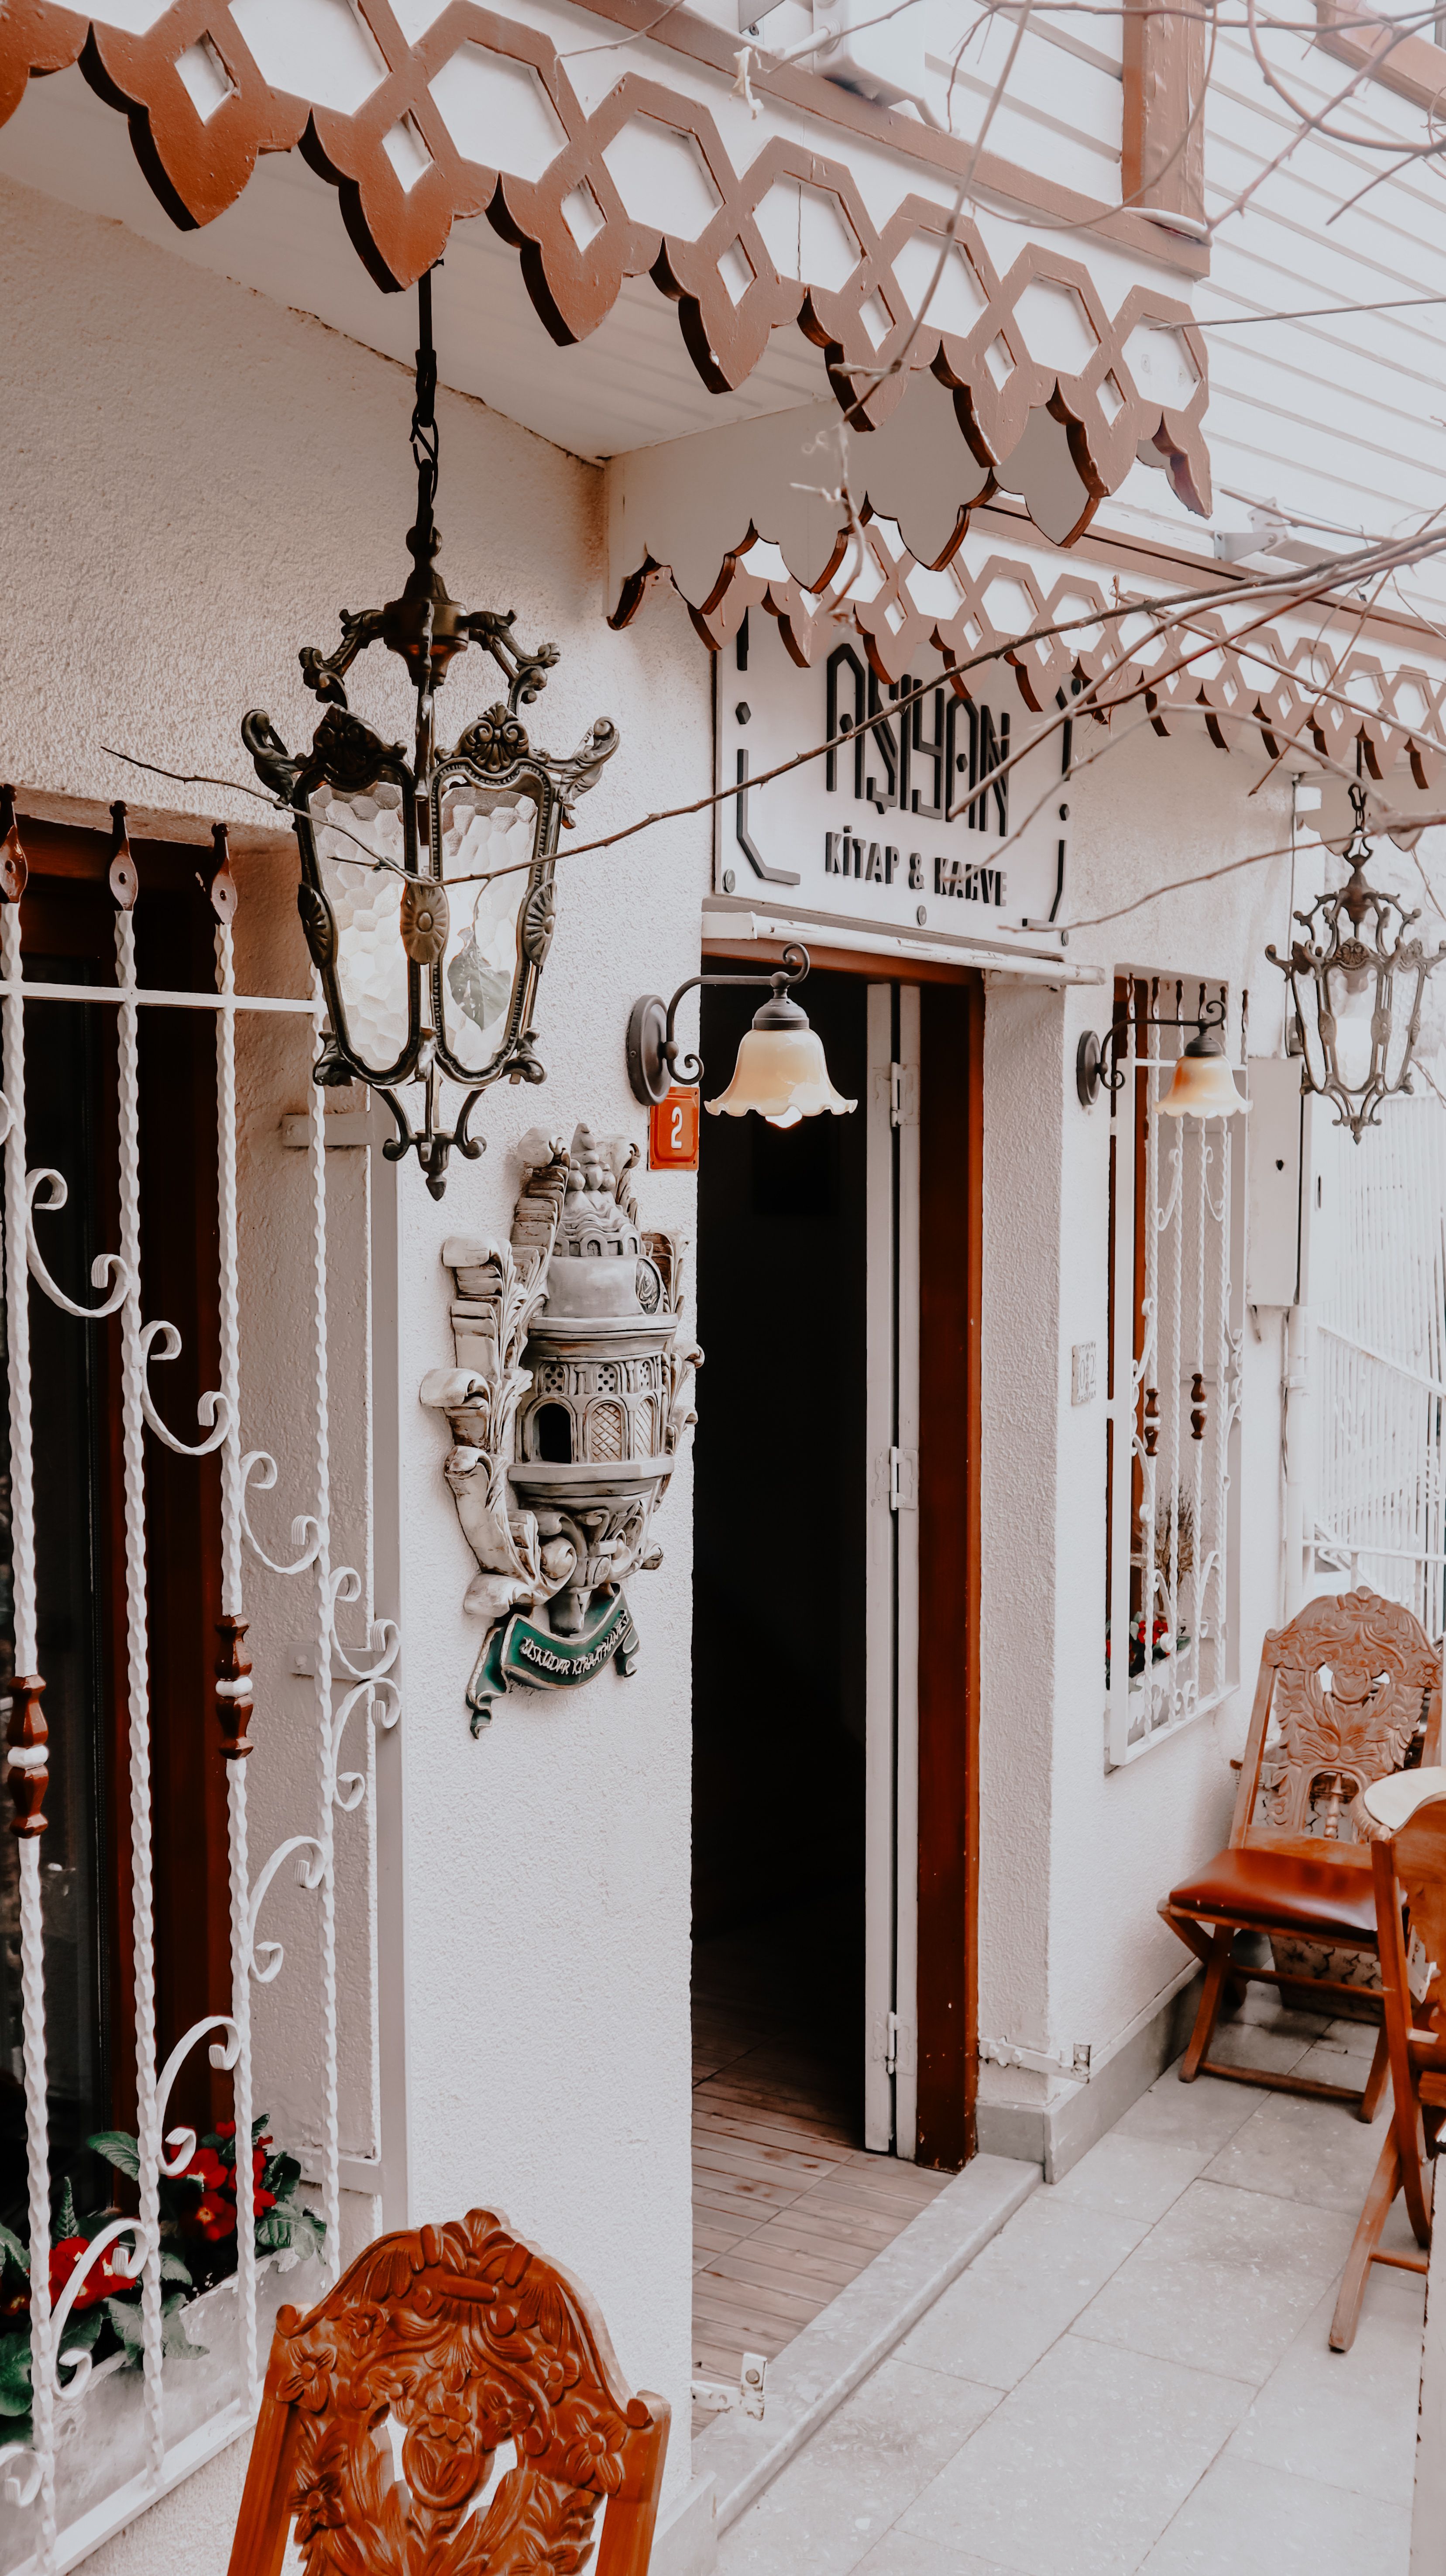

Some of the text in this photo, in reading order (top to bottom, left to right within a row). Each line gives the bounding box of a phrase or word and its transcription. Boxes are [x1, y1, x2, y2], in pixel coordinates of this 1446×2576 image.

[825, 825, 1007, 906] KİTAP & KAHVE
[671, 1107, 683, 1149] 2
